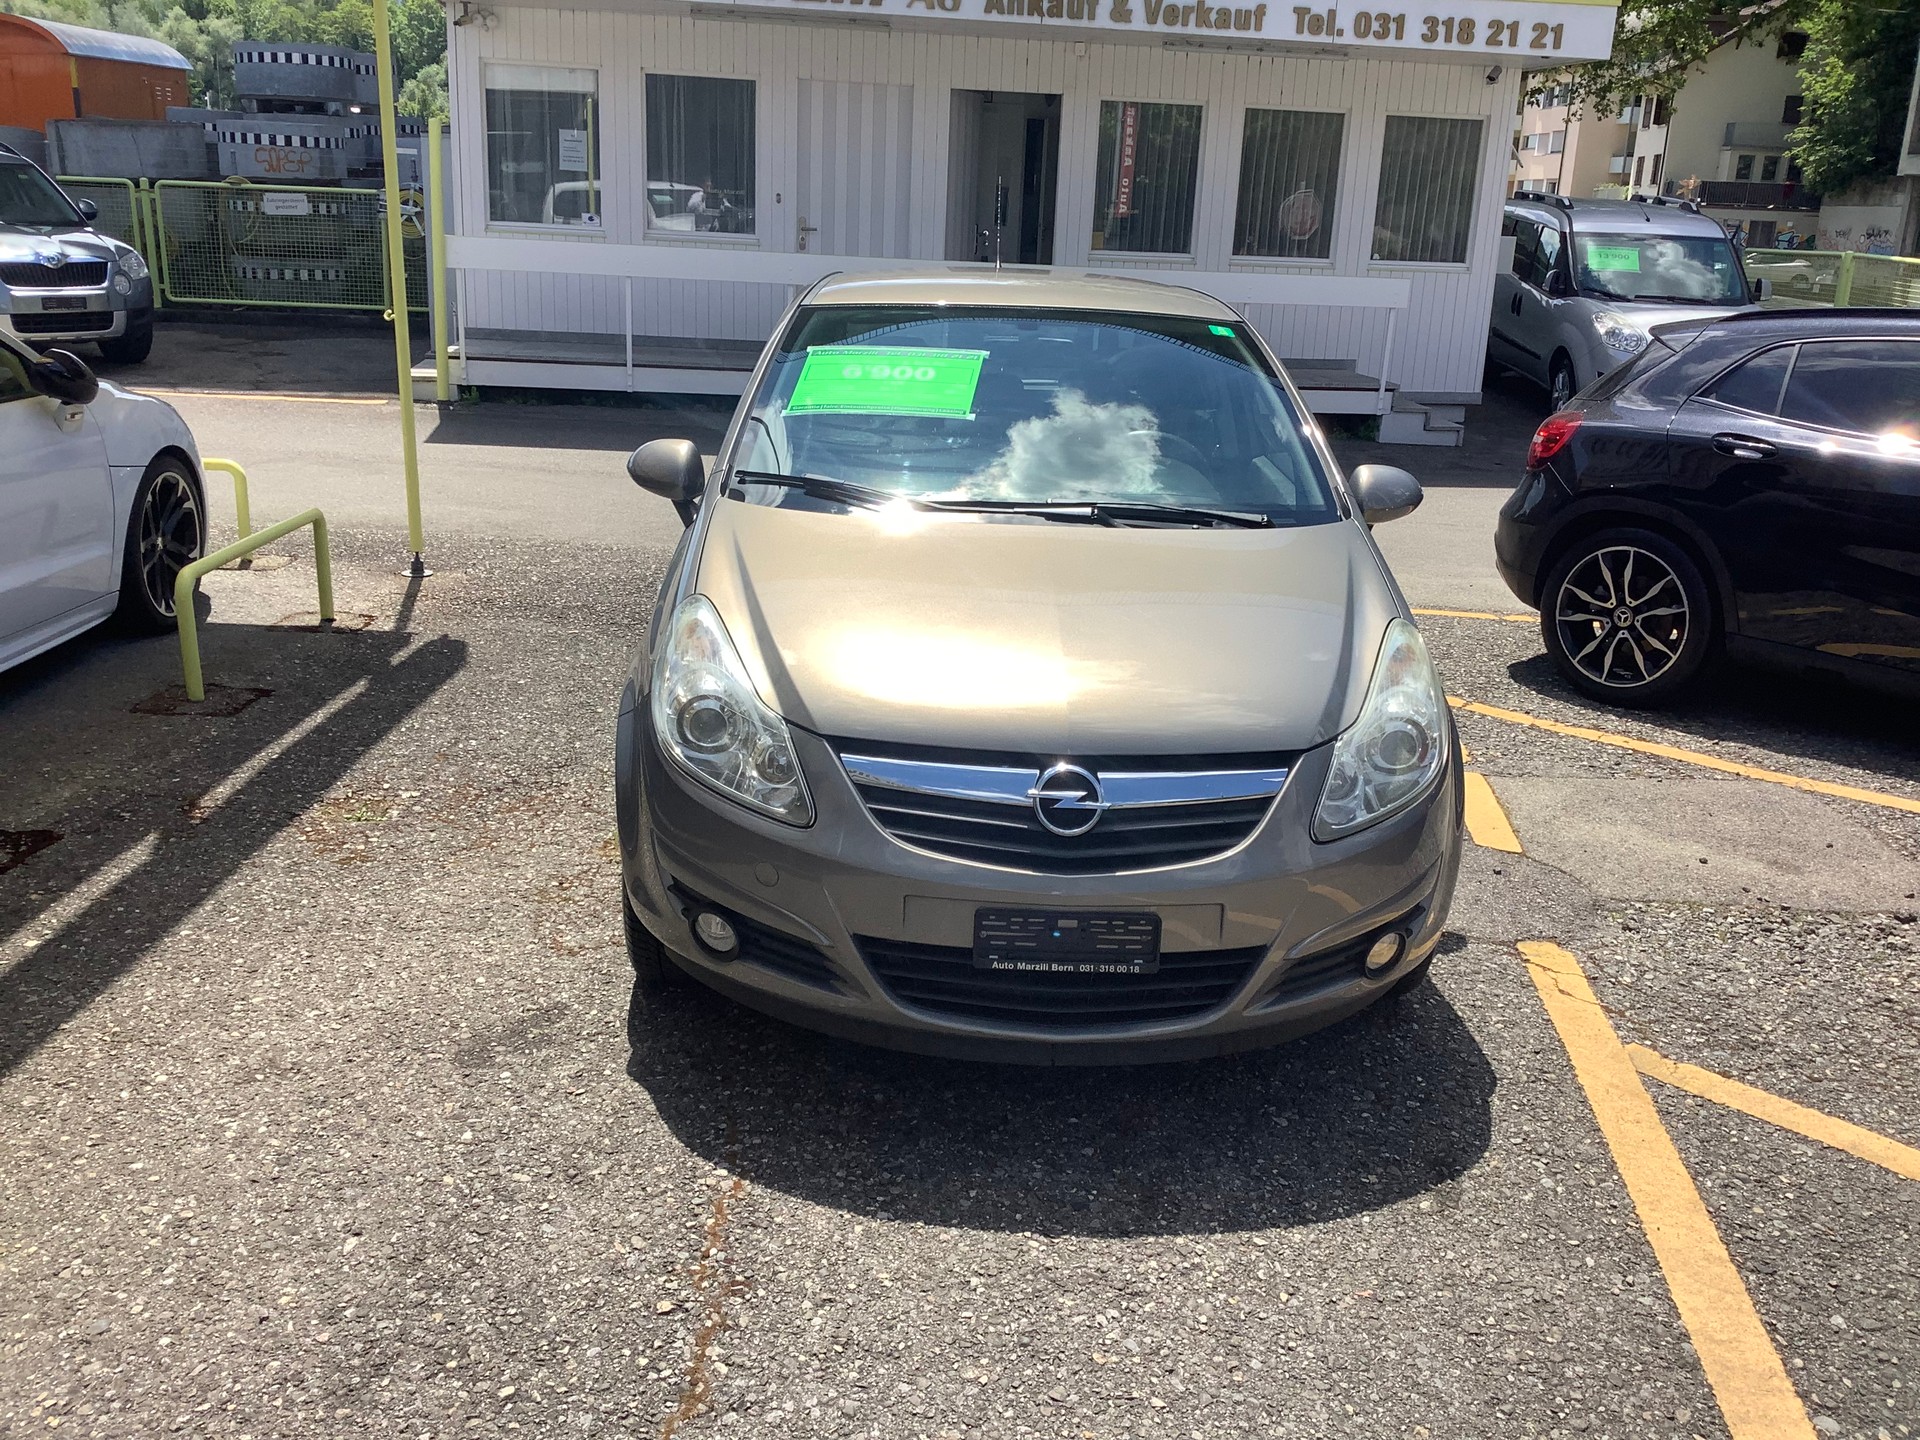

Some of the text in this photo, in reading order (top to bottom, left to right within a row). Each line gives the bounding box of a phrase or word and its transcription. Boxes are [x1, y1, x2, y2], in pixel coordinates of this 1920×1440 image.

[984, 0, 1100, 21] Ankauf
[1109, 0, 1133, 24] &
[1143, 2, 1267, 32] Verkauf
[1293, 7, 1344, 37] Tel.
[1354, 11, 1406, 41] 031
[1421, 16, 1476, 44] 318
[1485, 19, 1520, 48] 21
[1530, 22, 1564, 50] 21
[992, 961, 1014, 970] Auto
[1016, 962, 1049, 972] Marzili
[1051, 963, 1074, 972] Bern
[1116, 965, 1127, 973] 00
[1129, 965, 1140, 973] 18
